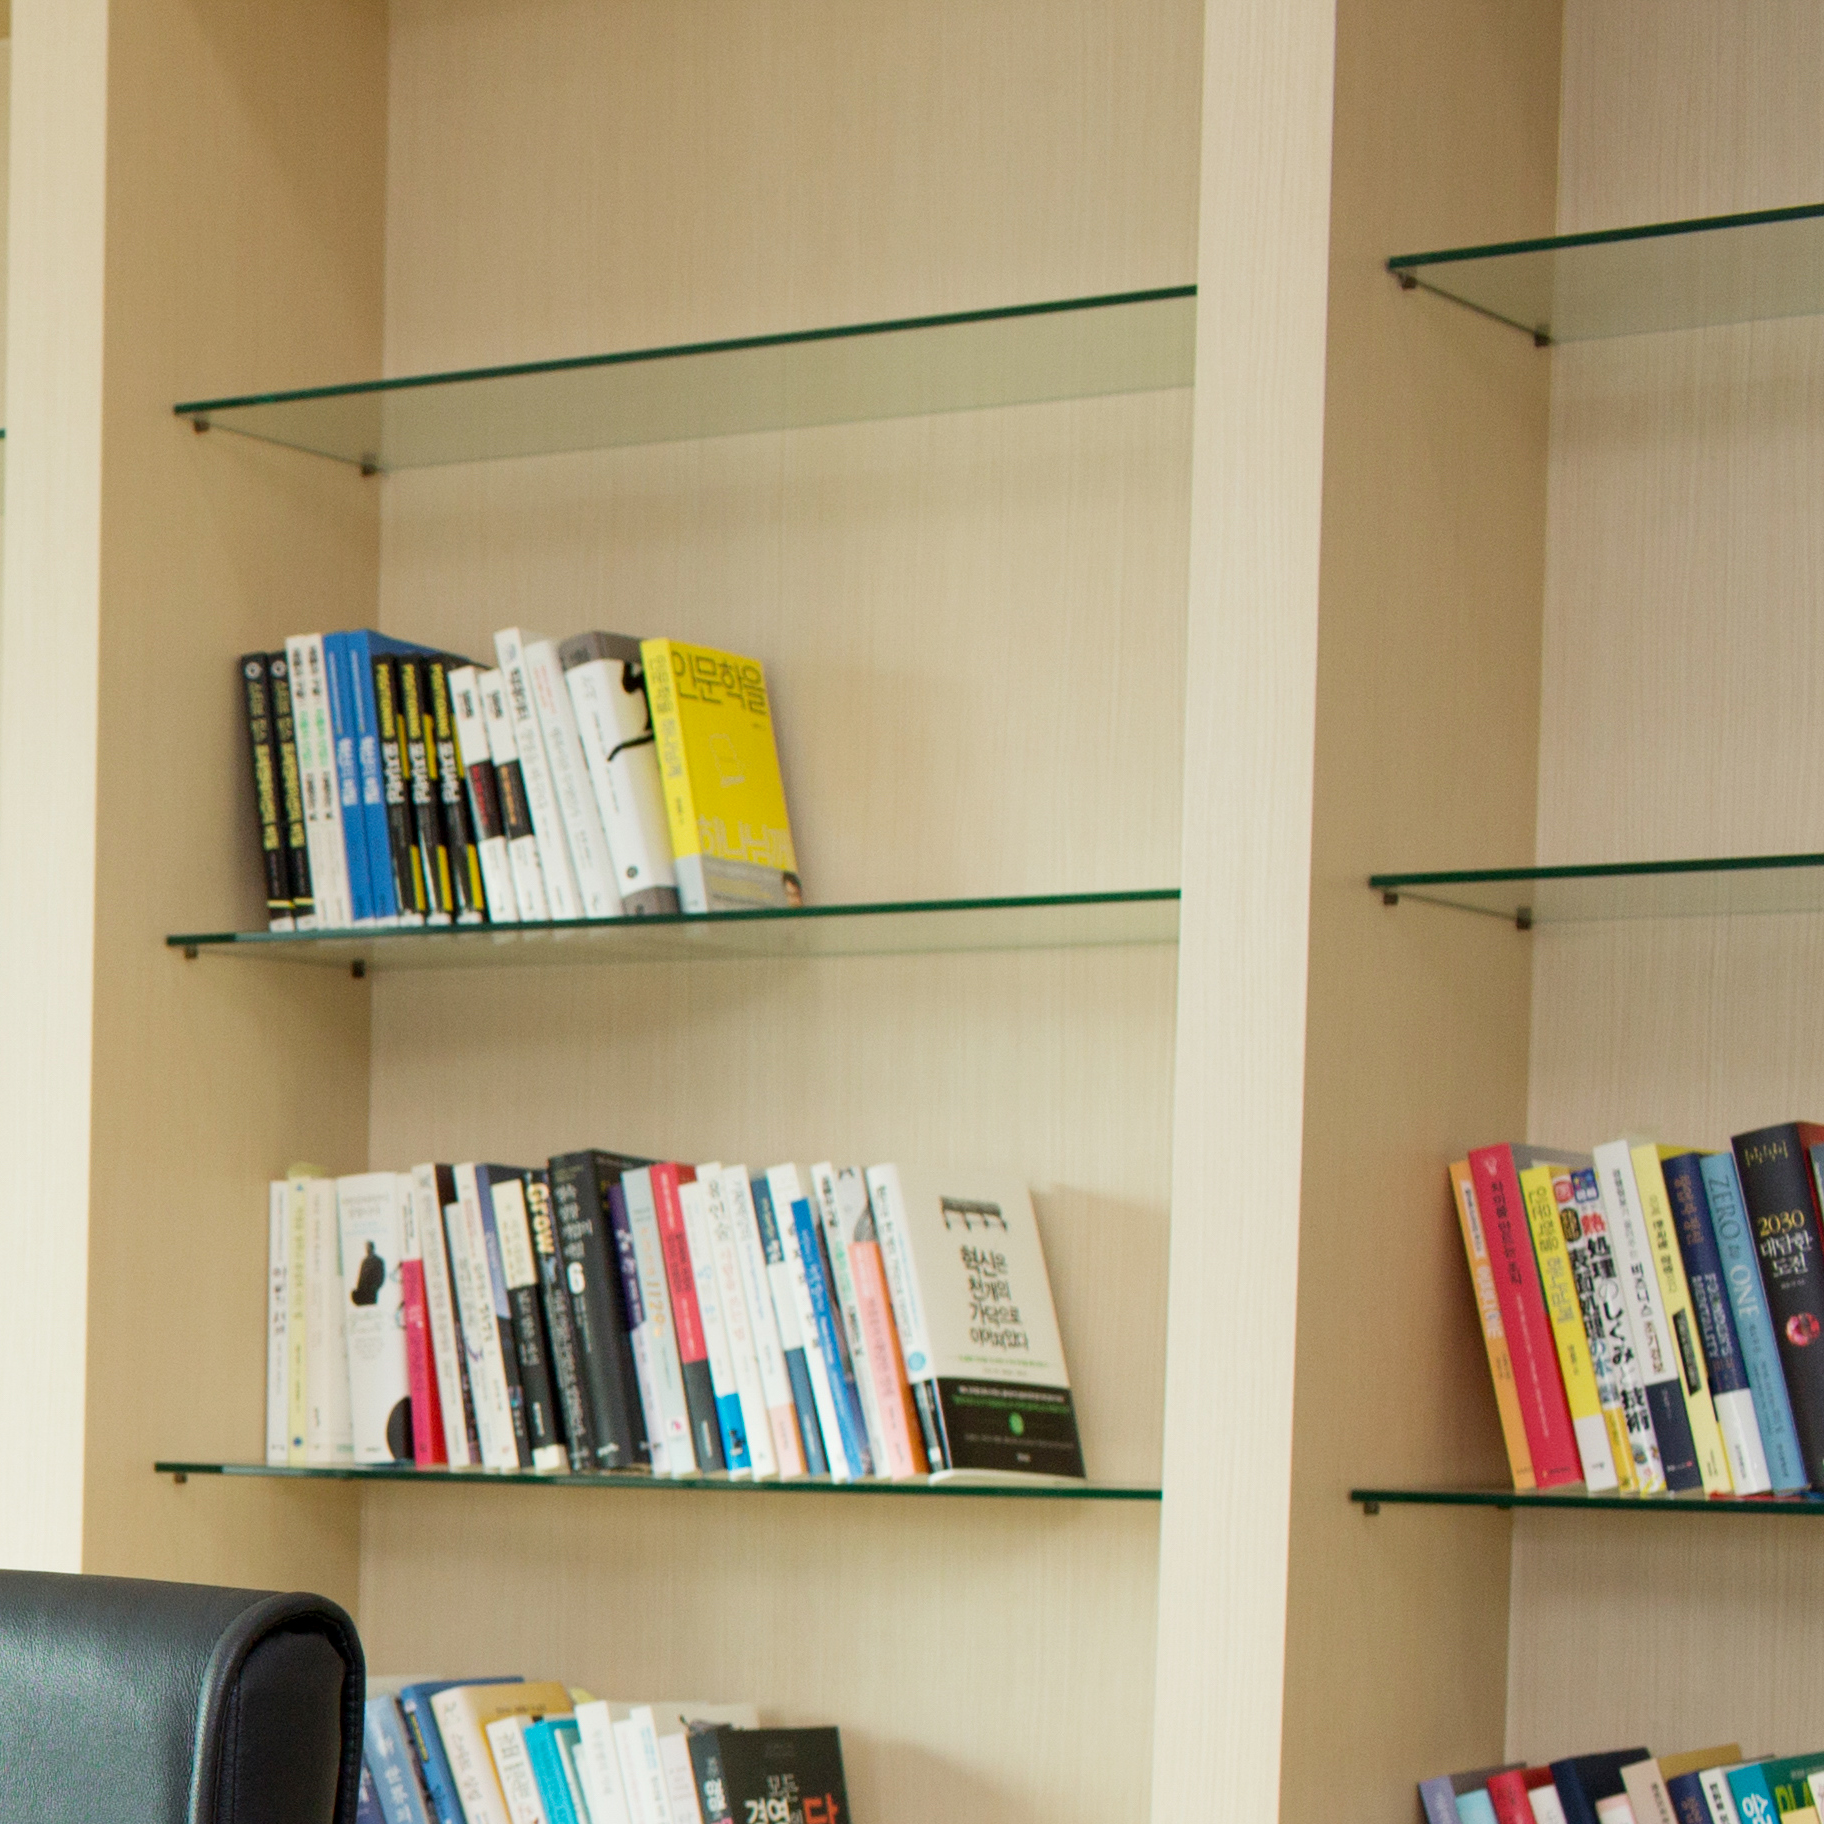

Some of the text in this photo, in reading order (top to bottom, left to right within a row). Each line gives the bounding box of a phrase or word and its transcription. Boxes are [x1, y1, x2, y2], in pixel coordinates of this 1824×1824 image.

[671, 650, 768, 716] 인문학을
[1757, 1209, 1806, 1238] 2030
[960, 1244, 1009, 1277] 혁신은
[1707, 1173, 1742, 1242] ZERO
[1729, 1264, 1761, 1318] ONE
[567, 1261, 586, 1295] 6
[1772, 1253, 1810, 1279] 도전
[969, 1302, 1022, 1329] 가닥으로
[766, 1772, 801, 1804] 모든
